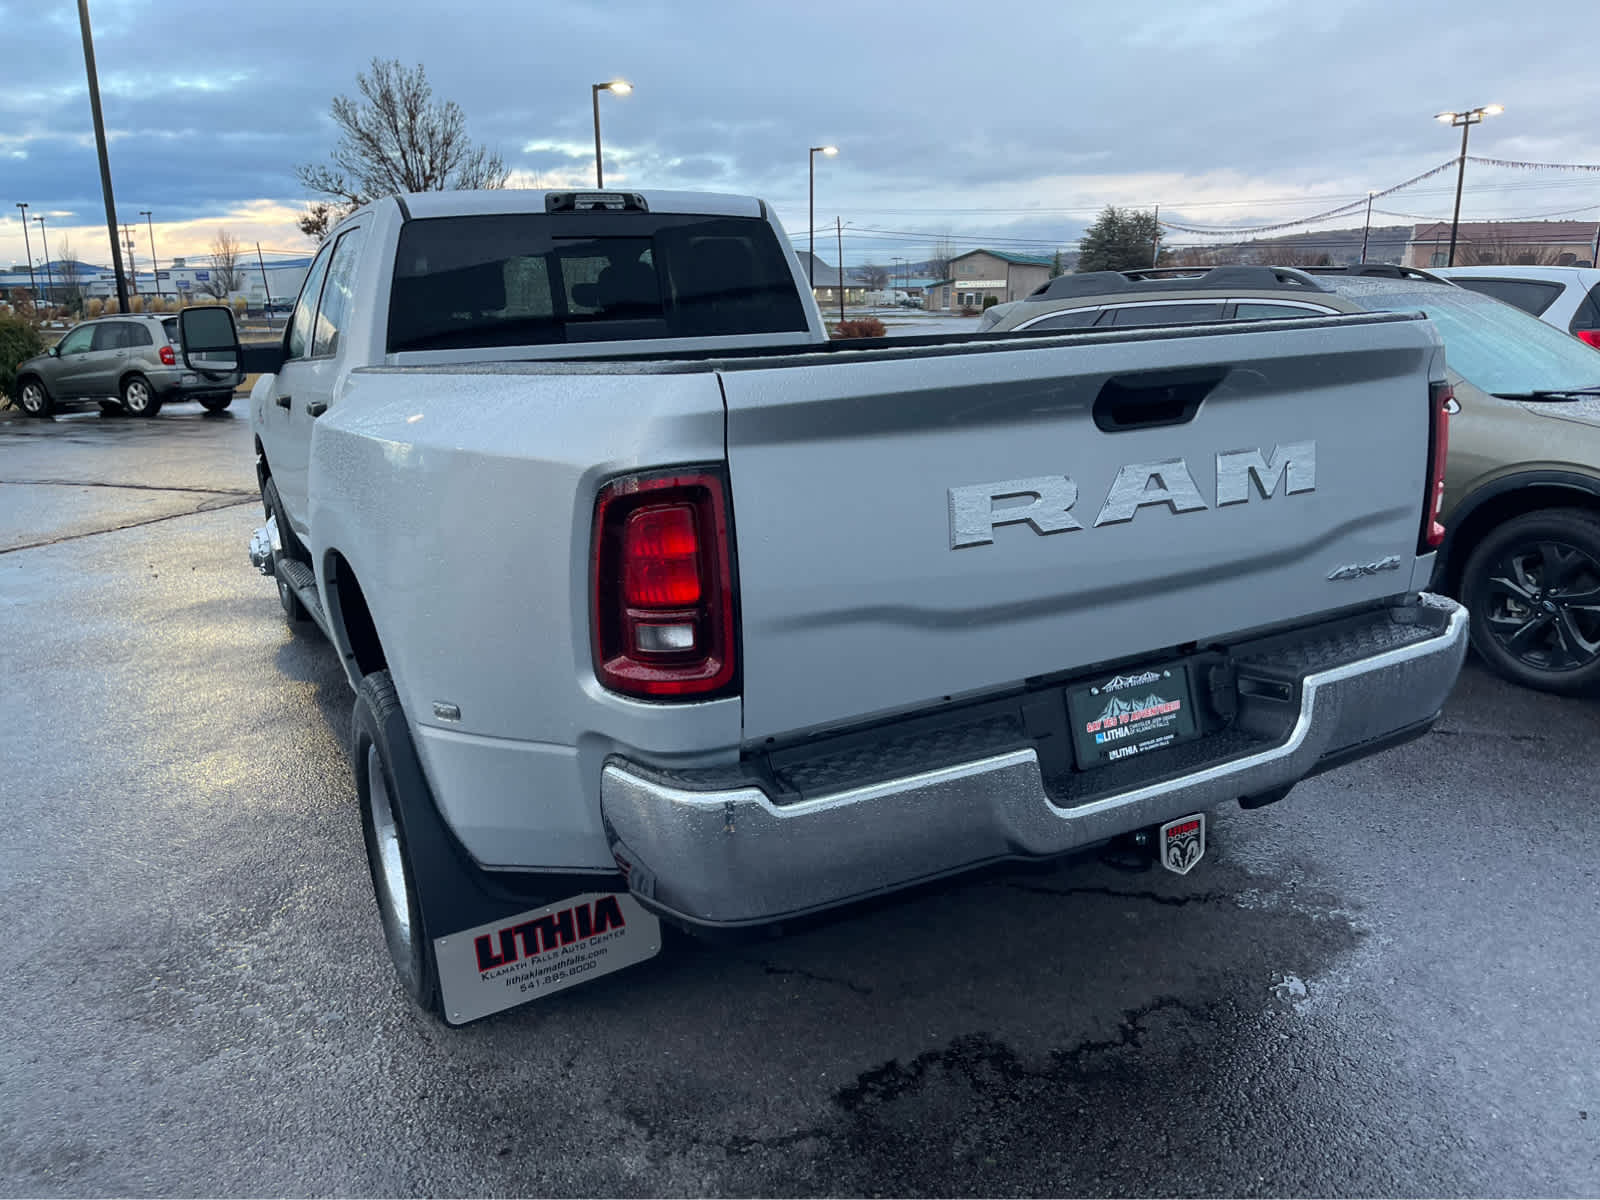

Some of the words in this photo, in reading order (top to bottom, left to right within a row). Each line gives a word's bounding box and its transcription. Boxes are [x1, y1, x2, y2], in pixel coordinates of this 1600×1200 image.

[947, 440, 1316, 551] RAM
[1103, 726, 1130, 742] LITHIA
[474, 894, 625, 973] LITHIA
[506, 947, 608, 987] lithiaklamathfalls.com
[520, 960, 597, 993] 541.885.8000
